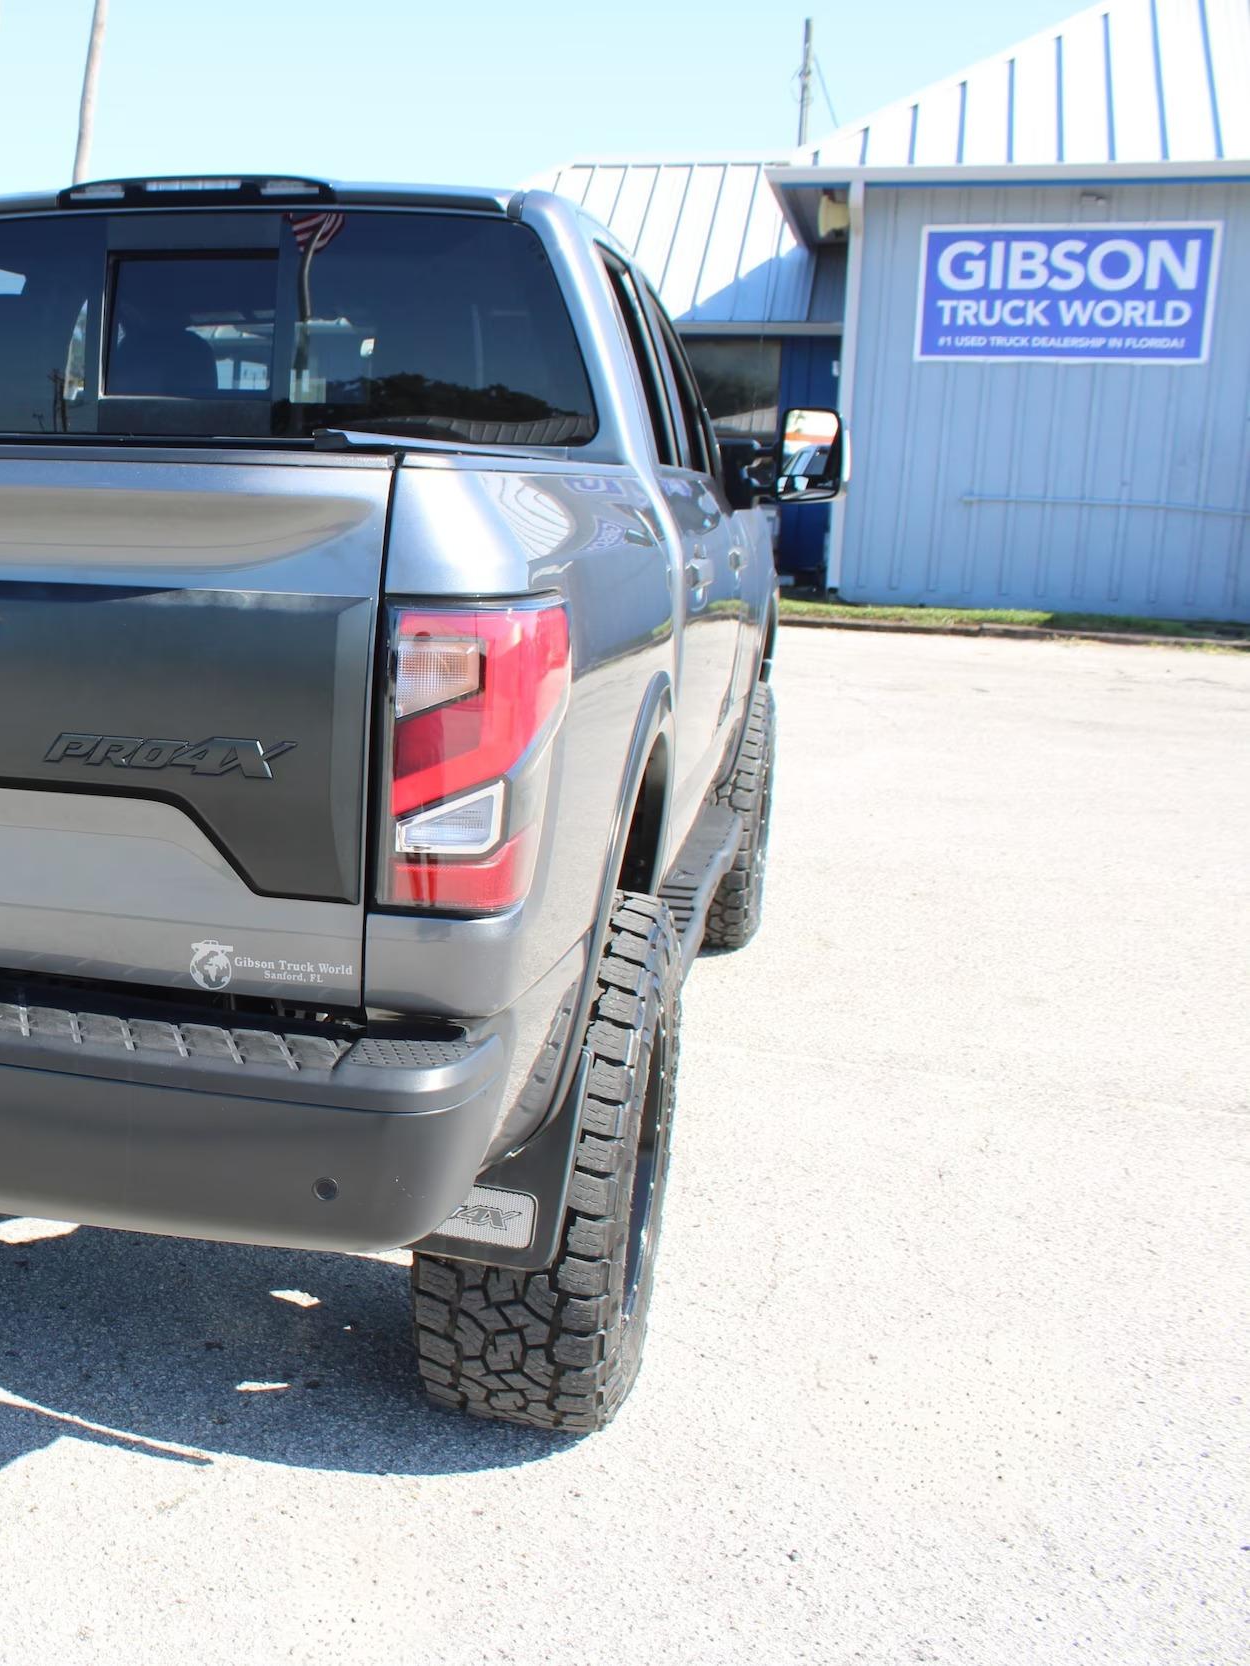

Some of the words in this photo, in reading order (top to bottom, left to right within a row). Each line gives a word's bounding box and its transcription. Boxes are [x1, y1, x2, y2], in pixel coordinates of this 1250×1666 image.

[937, 238, 1202, 291] GIBSON
[937, 299, 1050, 327] TRUCK
[1059, 299, 1192, 328] WORLD
[938, 336, 952, 347] #1
[955, 336, 986, 347] USED
[990, 336, 1029, 348] TRUCK
[1031, 336, 1106, 349] DEALERSHIP
[1108, 337, 1122, 348] IN
[1124, 337, 1184, 349] FLORIDA!
[234, 956, 275, 970] Gibson
[278, 959, 314, 973] Truck
[318, 963, 353, 975] World
[264, 971, 306, 983] Sanford,
[309, 974, 323, 983] FL
